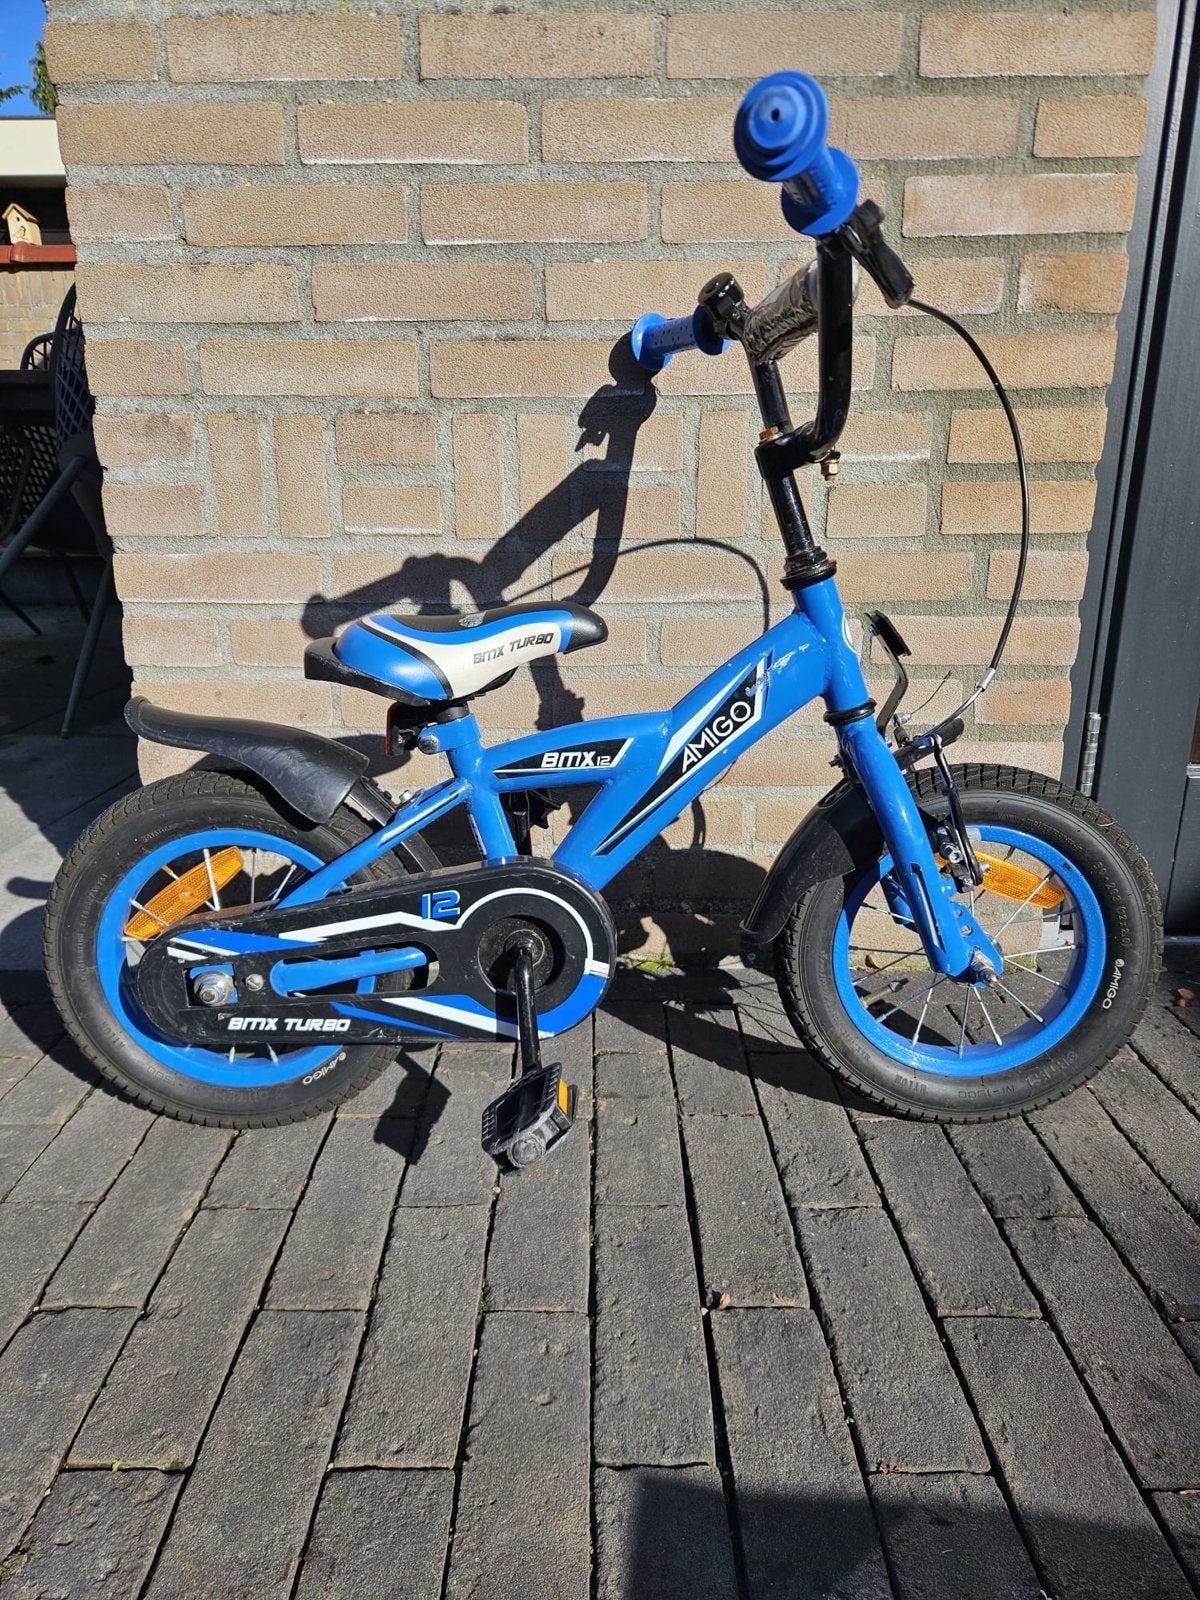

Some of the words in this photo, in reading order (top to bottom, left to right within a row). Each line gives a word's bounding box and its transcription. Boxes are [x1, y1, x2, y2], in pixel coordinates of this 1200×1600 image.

[473, 645, 505, 664] BMX
[509, 632, 554, 652] TURBO
[681, 701, 751, 773] AMIGO
[421, 889, 461, 920] 12
[1102, 966, 1122, 1010] AMIGO
[227, 1017, 279, 1031] BMX
[284, 1018, 351, 1032] TURBO
[303, 1057, 339, 1085] AMIGO
